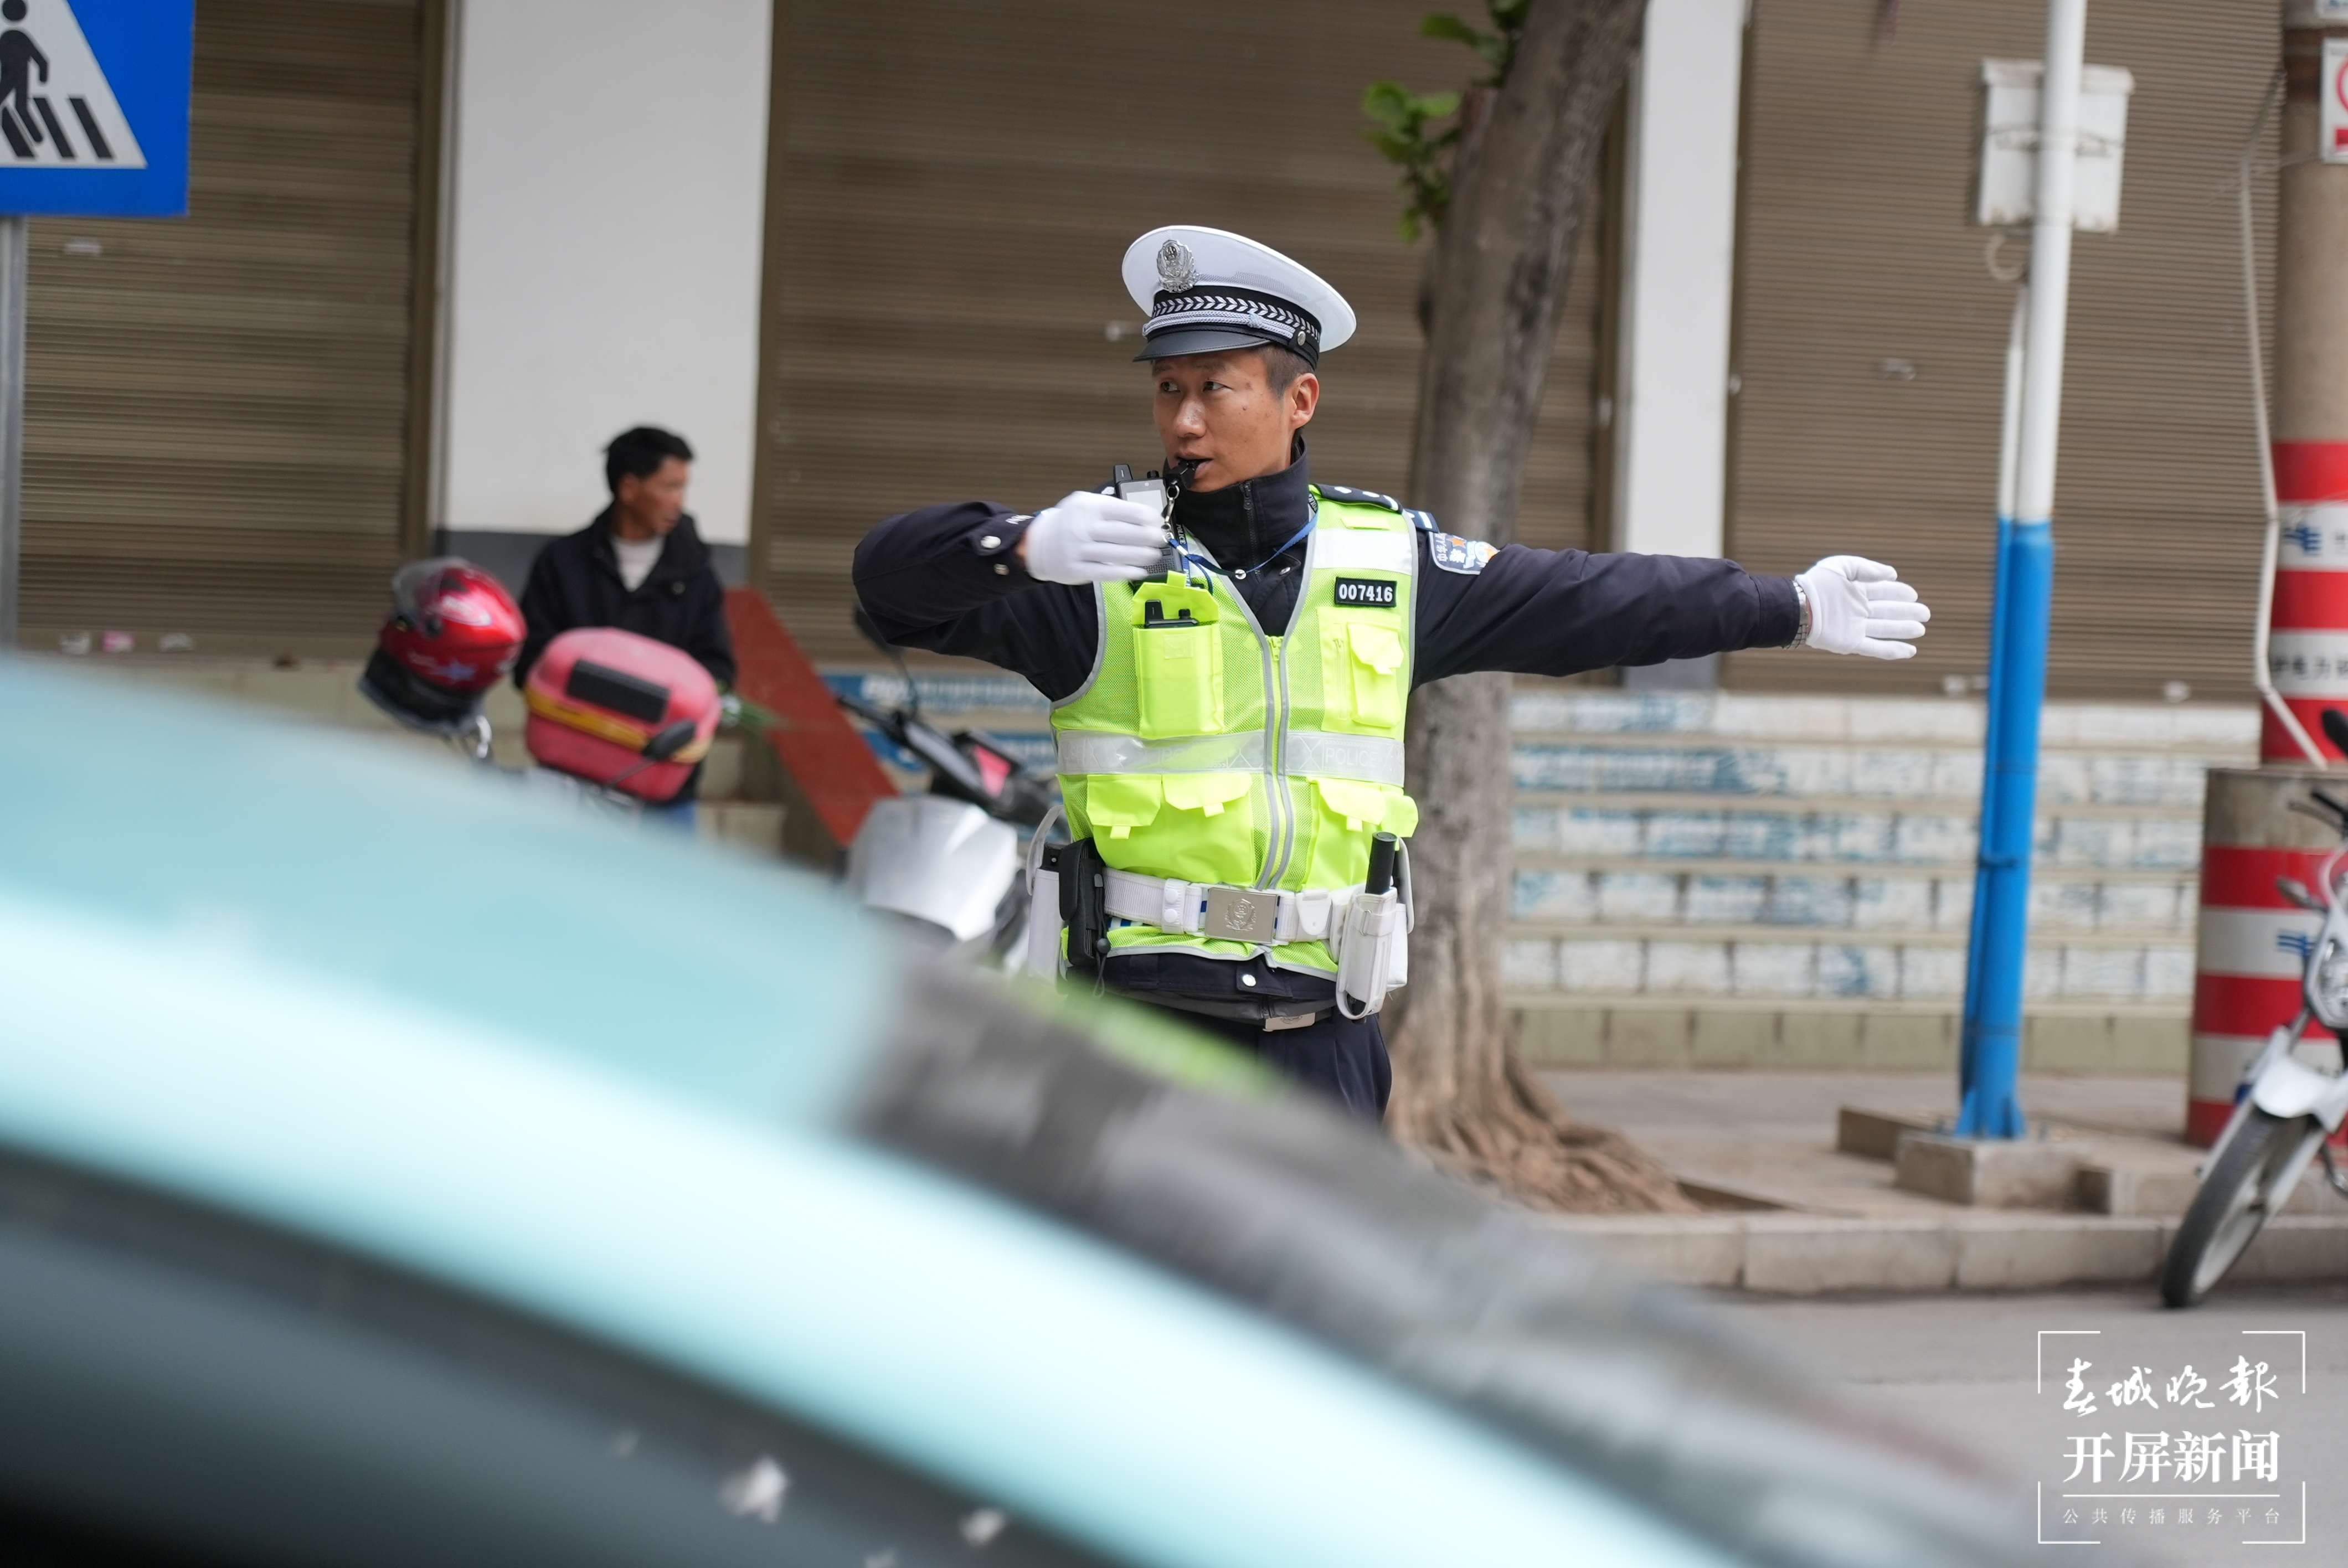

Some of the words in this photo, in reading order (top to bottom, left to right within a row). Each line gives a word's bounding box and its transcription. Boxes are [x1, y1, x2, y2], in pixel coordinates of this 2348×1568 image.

[1175, 523, 1186, 544] POLICE
[1338, 584, 1393, 602] 007416
[1325, 747, 1379, 768] POLICE
